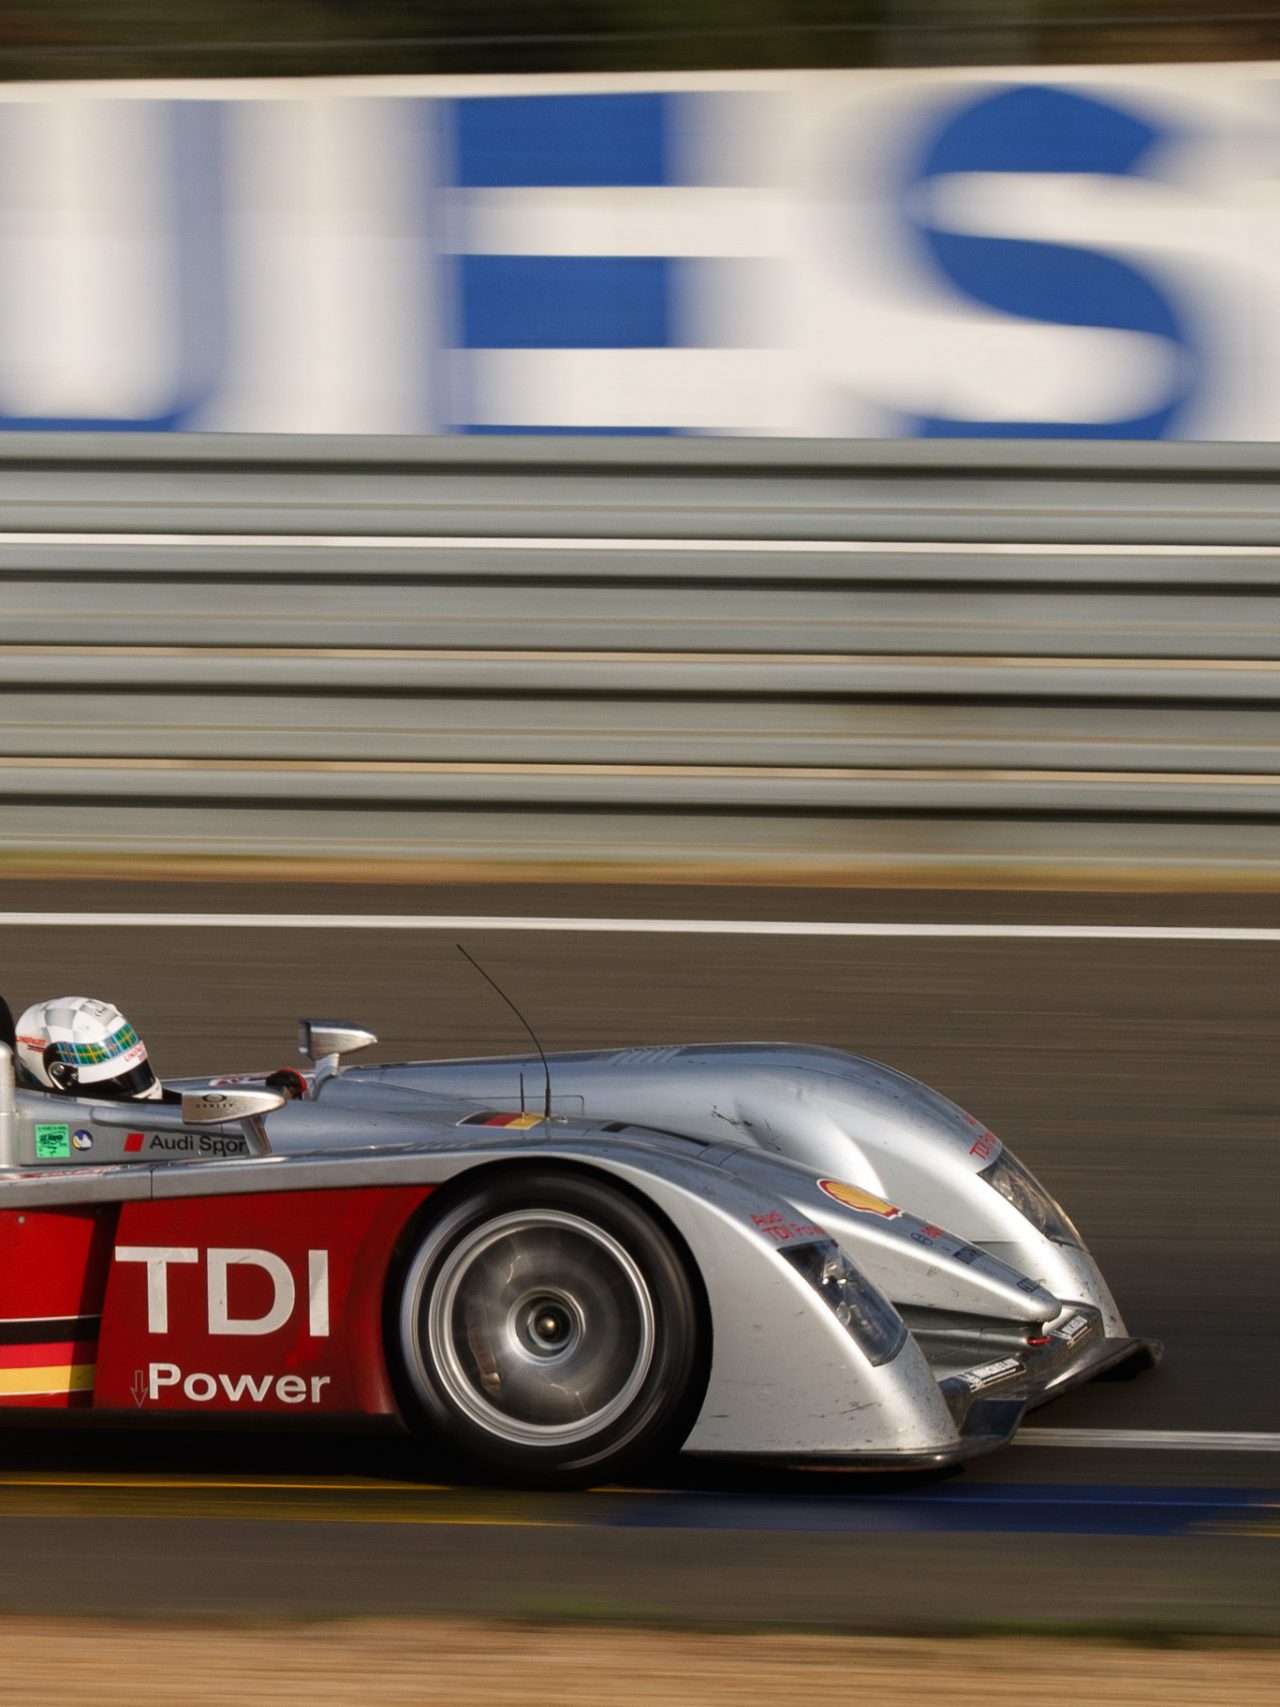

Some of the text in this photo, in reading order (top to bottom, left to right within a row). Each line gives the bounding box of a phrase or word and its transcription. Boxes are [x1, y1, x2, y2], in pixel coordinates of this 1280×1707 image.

[149, 1135, 247, 1156] Audi Spor
[115, 1246, 330, 1337] TDI
[149, 1362, 330, 1404] Power
